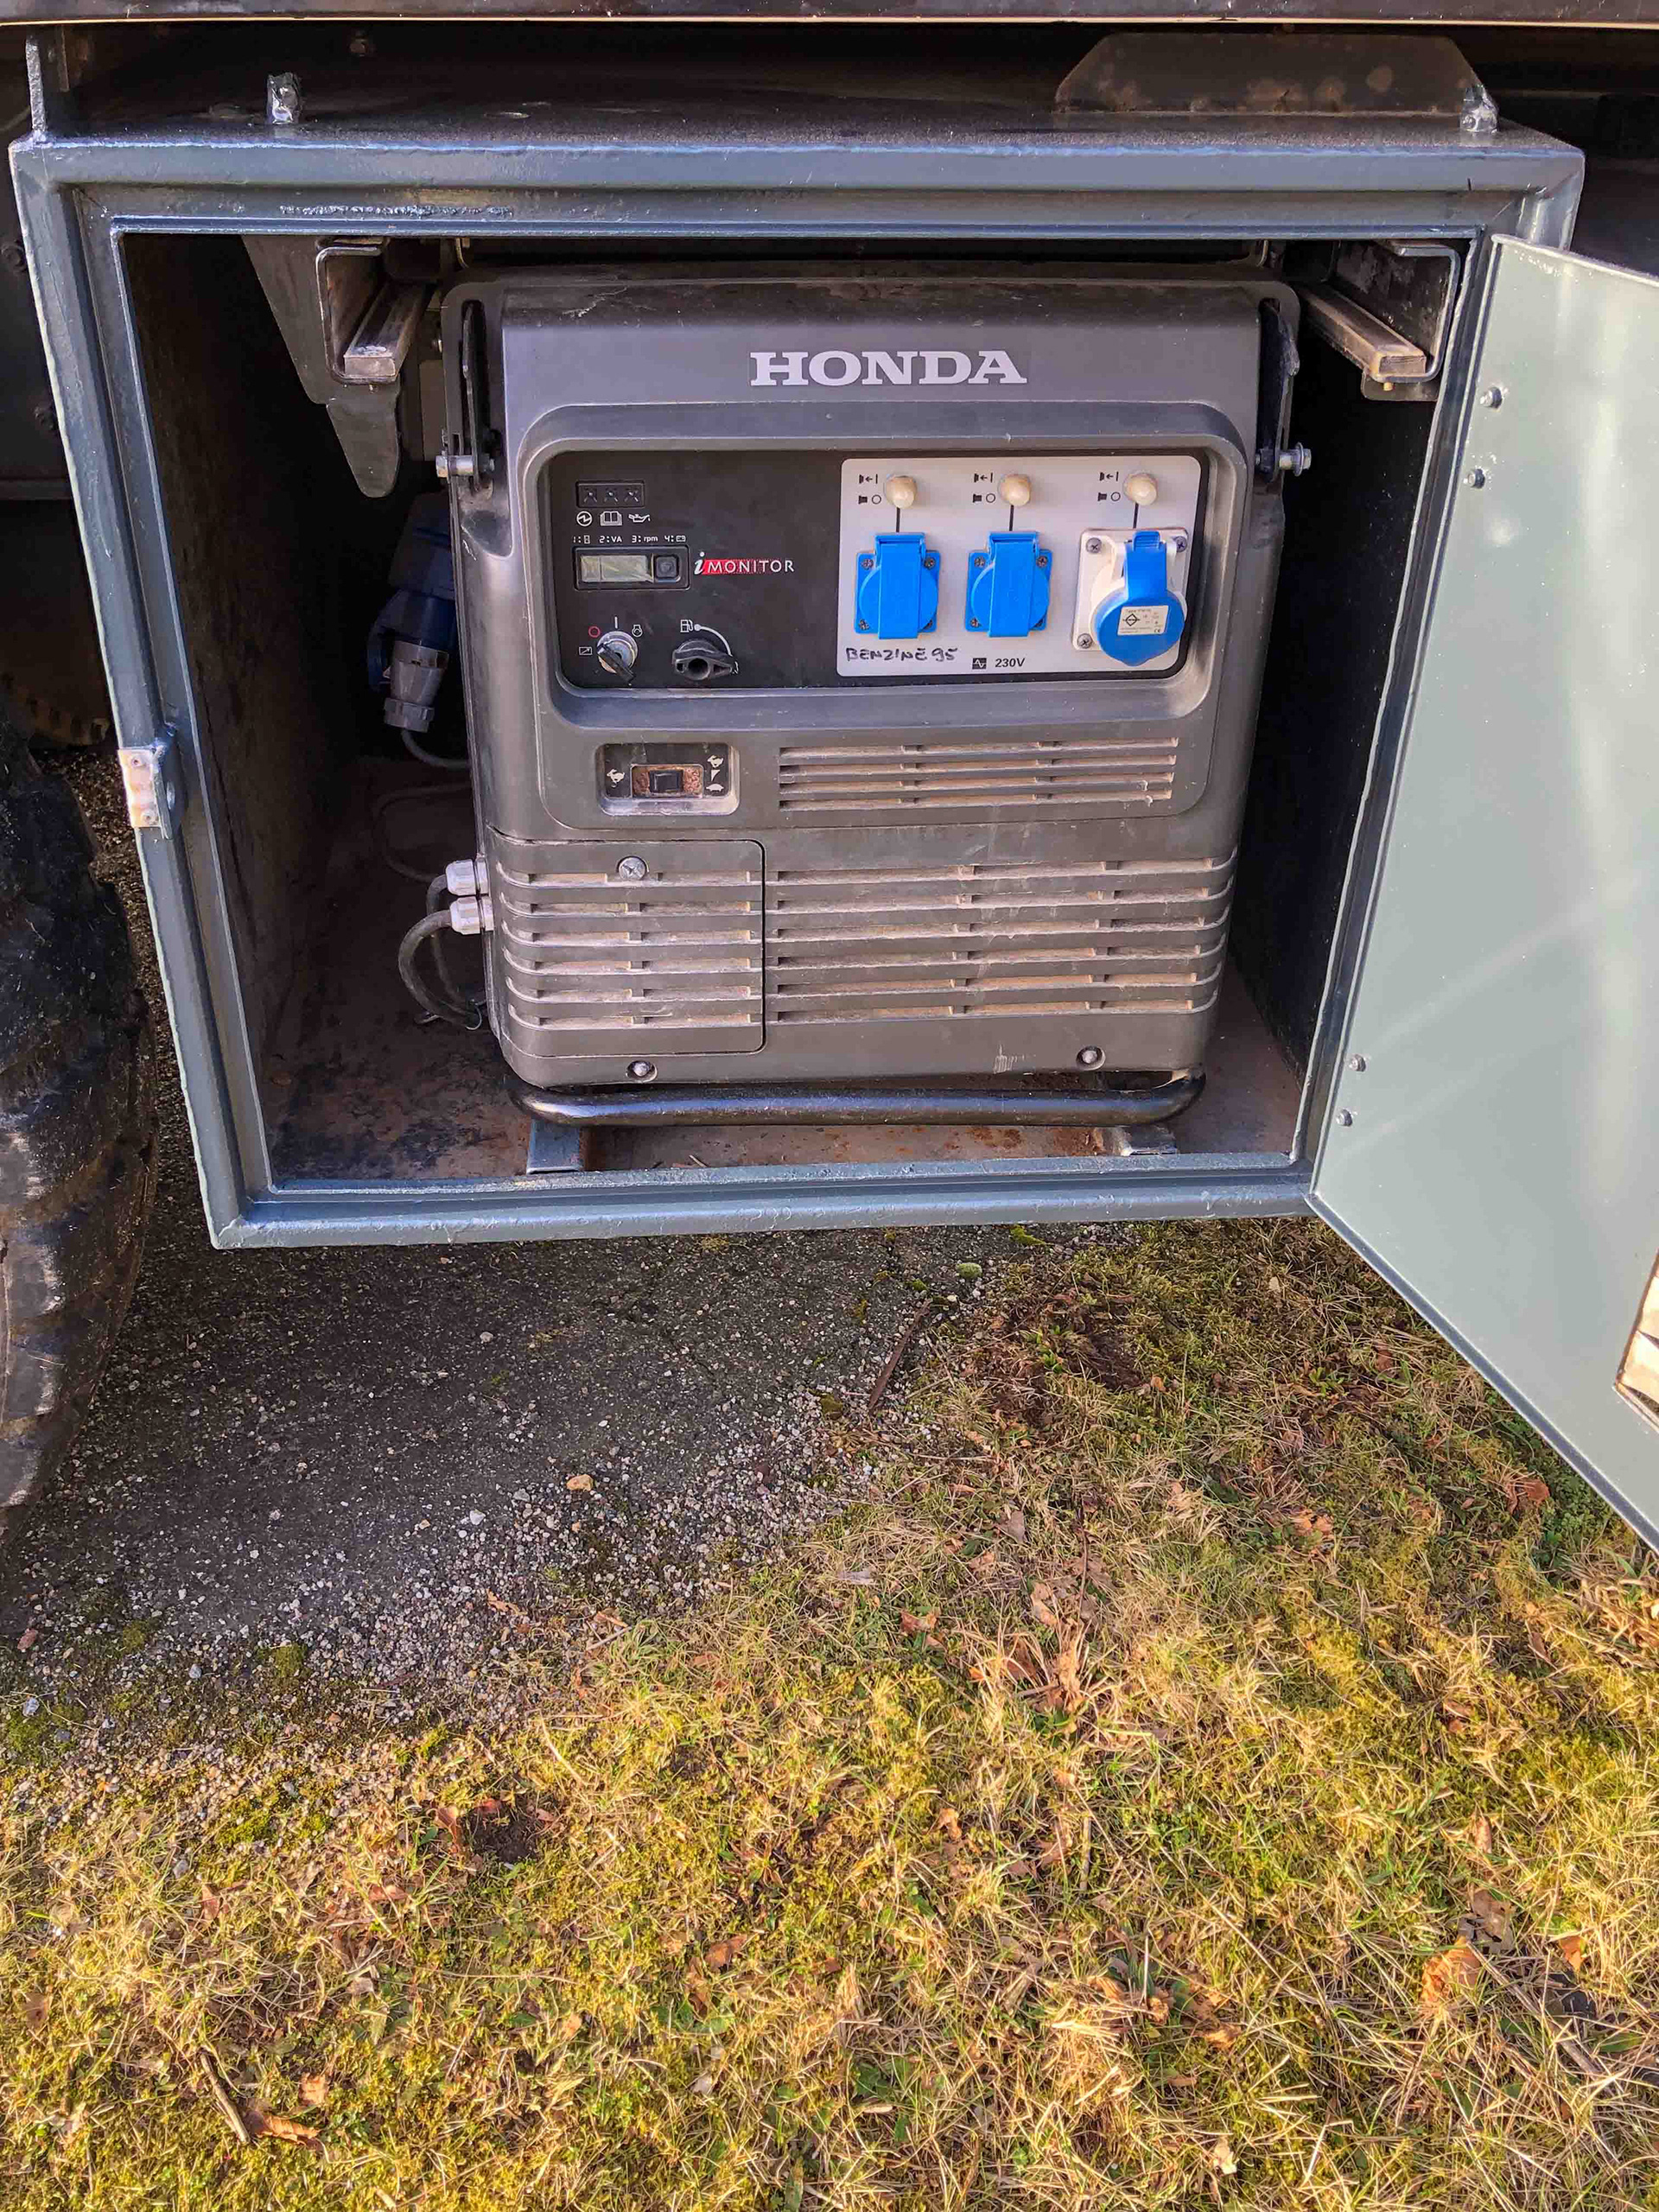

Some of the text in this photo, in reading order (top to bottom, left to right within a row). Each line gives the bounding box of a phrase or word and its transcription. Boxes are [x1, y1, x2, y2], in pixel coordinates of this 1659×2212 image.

[750, 350, 1027, 386] HONDA
[845, 647, 958, 662] BENZINE 95
[995, 658, 1026, 668] 230V
